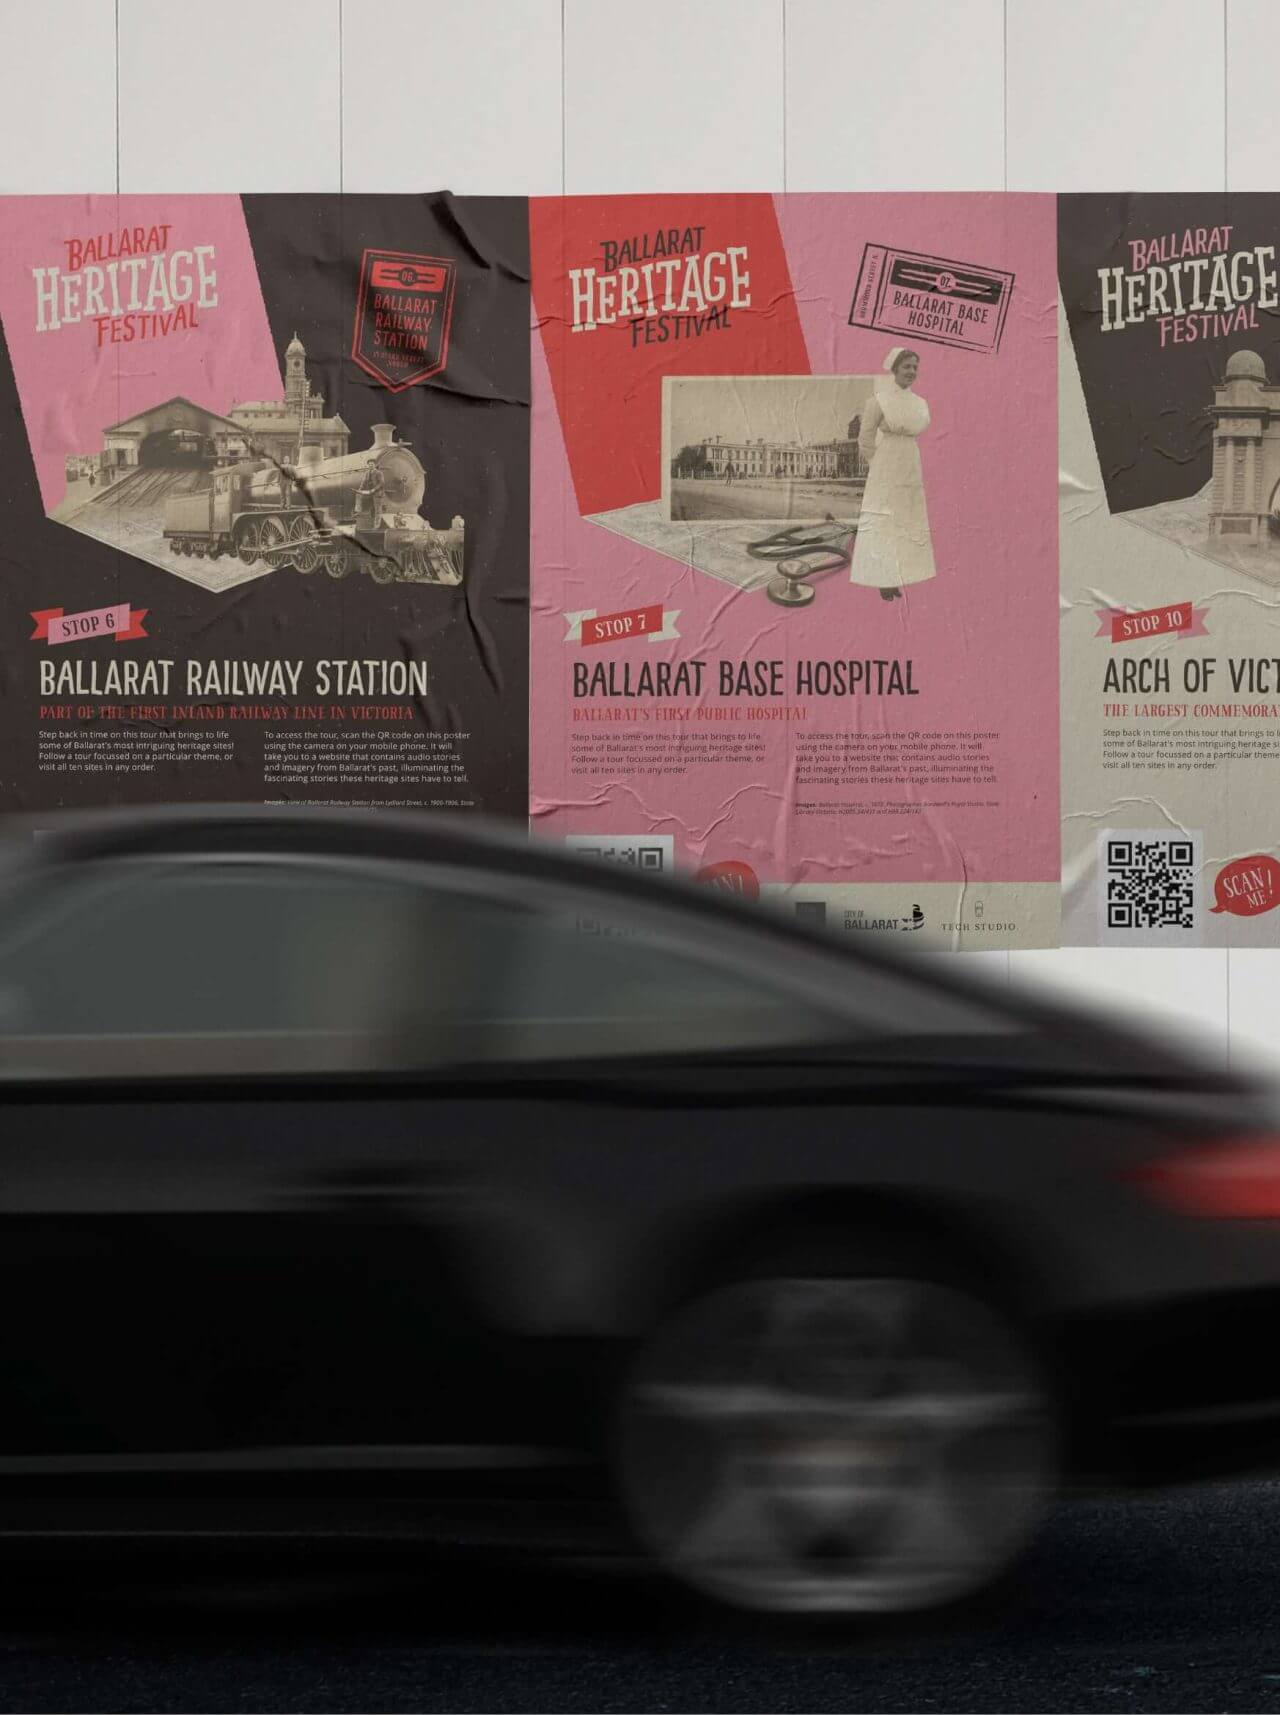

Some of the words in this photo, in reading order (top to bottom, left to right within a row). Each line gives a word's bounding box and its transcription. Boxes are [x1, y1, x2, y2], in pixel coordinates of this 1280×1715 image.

[64, 225, 172, 272] BALLARAT
[600, 226, 706, 272] BALLARAT
[1128, 226, 1233, 273] BALLARAT
[34, 246, 218, 332] HERITAGE
[569, 247, 751, 332] HERITAGE
[1098, 246, 1278, 332] HERITAGE
[374, 294, 437, 314] BALLARAT
[893, 291, 954, 316] BALLARAT
[957, 304, 989, 324] BASE
[93, 303, 199, 348] FESTIVAL
[375, 312, 432, 332] RAILWAY
[630, 305, 732, 348] FESTIVAL
[908, 311, 964, 336] HOSPITAL
[1156, 304, 1259, 347] FESTIVAL
[373, 330, 428, 350] STATION
[62, 616, 99, 637] STOP
[106, 613, 115, 628] 6
[595, 617, 633, 639] STOP
[638, 614, 646, 630] 7
[1123, 615, 1160, 636] STOP
[1165, 610, 1182, 628] 10
[40, 660, 174, 696] BALLARAT
[187, 660, 303, 696] RAILWAY
[316, 660, 427, 696] STATION
[573, 660, 706, 697] BALLARAT
[719, 660, 783, 697] BASE
[797, 660, 919, 697] HOSPITAL
[1103, 658, 1170, 694] ARCH
[1184, 658, 1216, 694] OF
[40, 706, 72, 720] PART
[78, 706, 93, 720] OF
[101, 706, 126, 720] THE
[131, 706, 166, 720] FIRST
[173, 706, 224, 720] INLAND
[230, 706, 288, 720] RAILWAY
[295, 706, 324, 720] LINE
[331, 706, 346, 720] IN
[352, 706, 414, 720] VICTORIA
[573, 707, 650, 721] BALLARAT'S
[655, 707, 690, 721] FIRST
[699, 707, 741, 721] PUBLIC
[747, 707, 808, 721] HOSPITAL
[1103, 704, 1129, 718] THE
[1134, 704, 1189, 718] LARGEST
[39, 730, 57, 740] Step
[59, 730, 77, 740] back
[80, 730, 87, 740] in
[89, 730, 108, 740] time
[110, 730, 120, 740] on
[123, 730, 138, 740] this
[140, 730, 157, 740] tour
[159, 730, 176, 740] that
[178, 730, 204, 740] brings
[206, 730, 214, 740] to
[216, 730, 229, 740] life
[844, 919, 899, 931] BALLARAT
[941, 923, 970, 931] TECH
